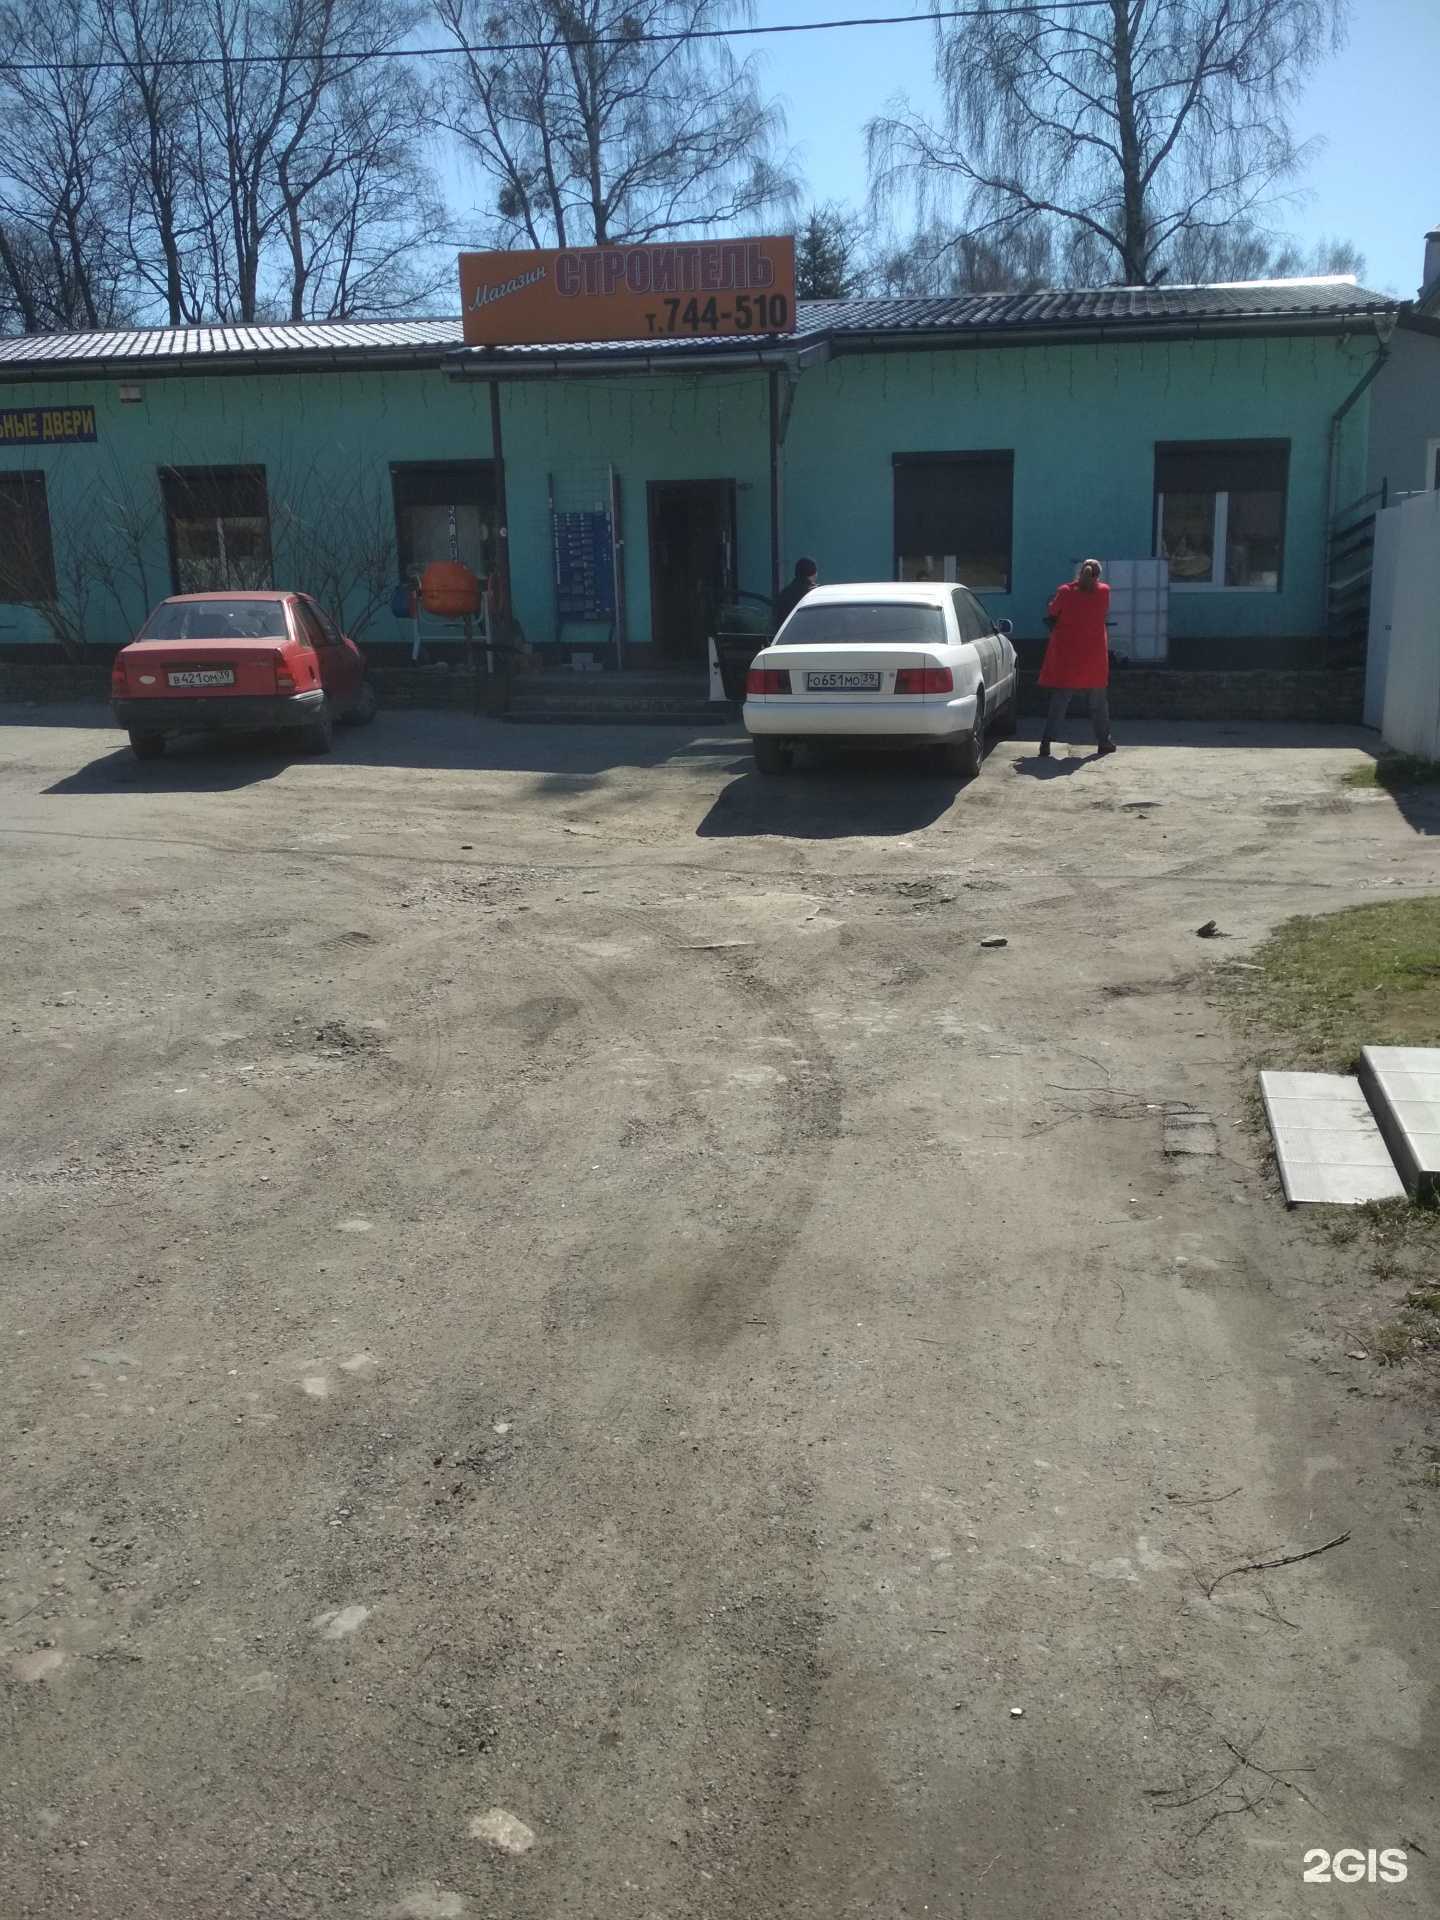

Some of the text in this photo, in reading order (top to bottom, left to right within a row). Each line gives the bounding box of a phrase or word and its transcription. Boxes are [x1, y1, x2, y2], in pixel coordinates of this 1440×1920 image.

[468, 264, 546, 311] Магазин
[554, 243, 775, 296] СТРОИТЕЛЬ
[42, 409, 94, 441] ДВЕРИ
